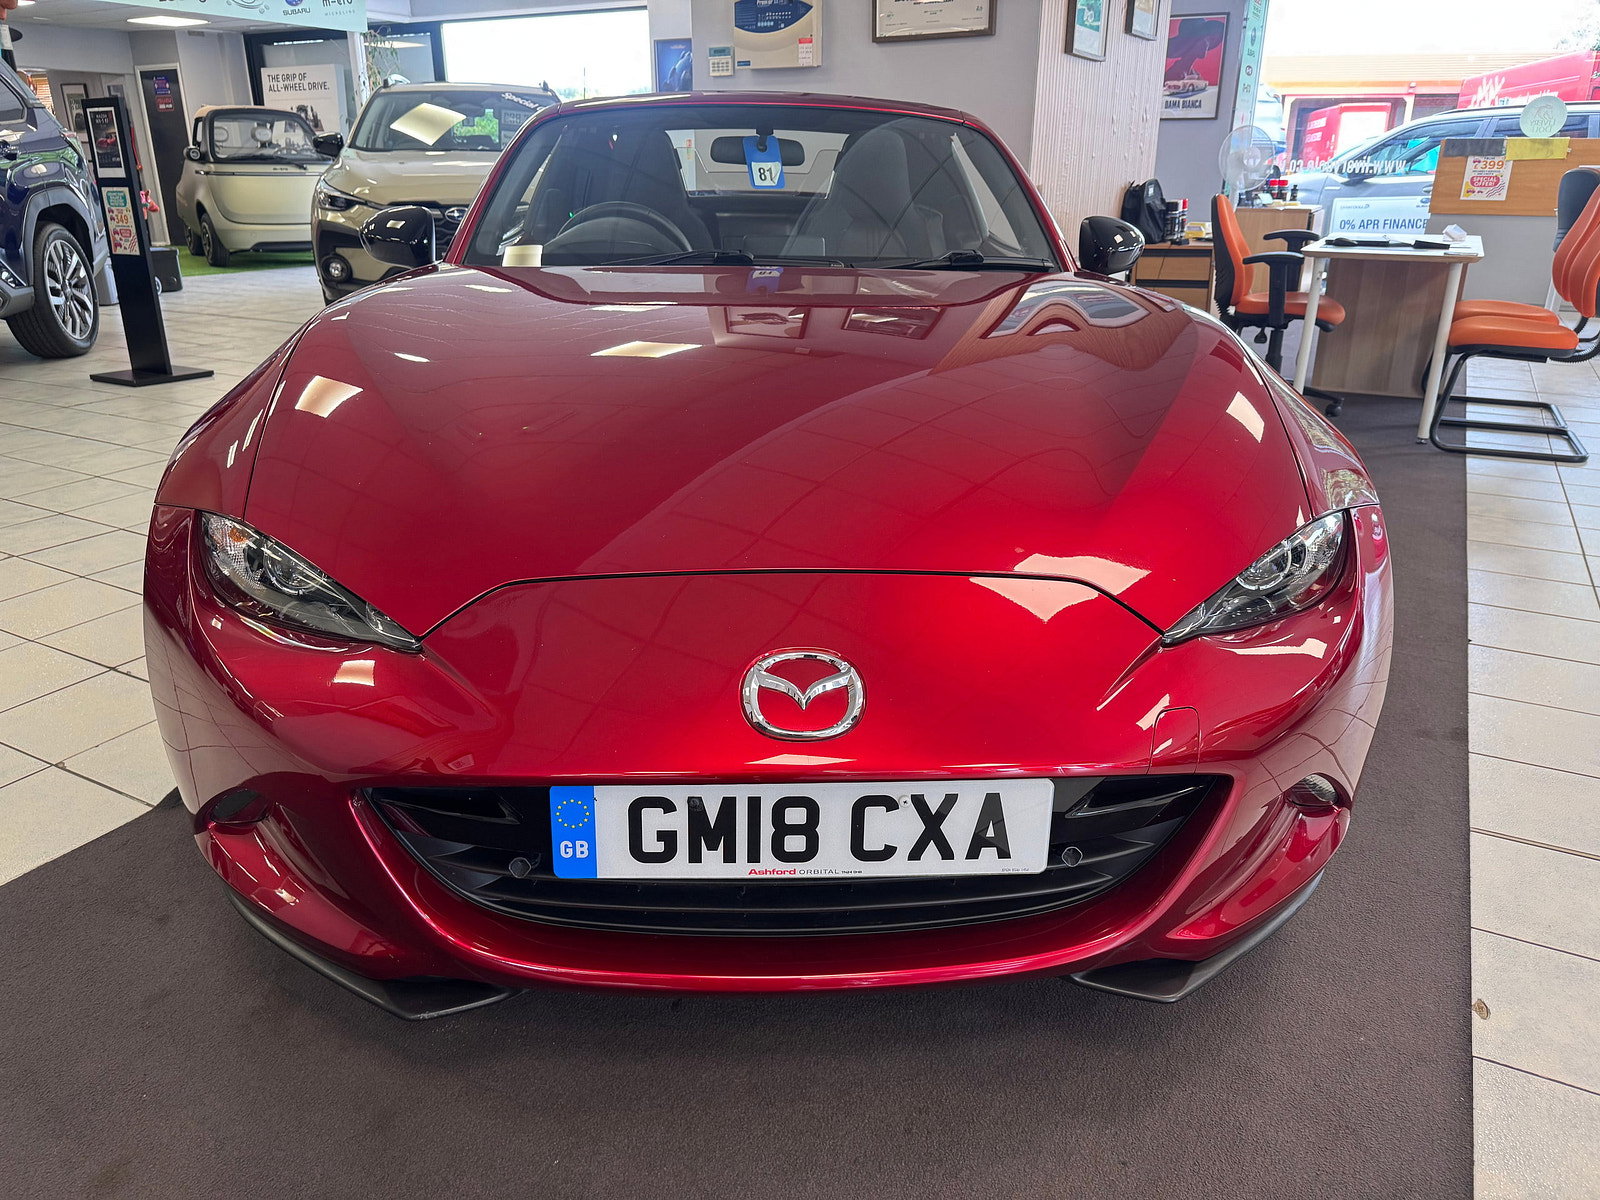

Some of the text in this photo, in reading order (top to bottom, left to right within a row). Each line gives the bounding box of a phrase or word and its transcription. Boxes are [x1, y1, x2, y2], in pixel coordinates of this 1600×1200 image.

[282, 7, 311, 16] SUBARU
[267, 72, 307, 83] THE GRIP OF
[268, 81, 330, 92] ALL-WHEEL DRIVE.
[1165, 100, 1180, 109] DAMA
[758, 167, 774, 182] 81
[1339, 219, 1356, 230] 0%
[1358, 219, 1380, 230] APR
[628, 793, 1012, 863] GM18 CXA
[560, 841, 589, 858] GB
[748, 868, 796, 876] Ashford
[798, 868, 839, 876] ORBITAL
